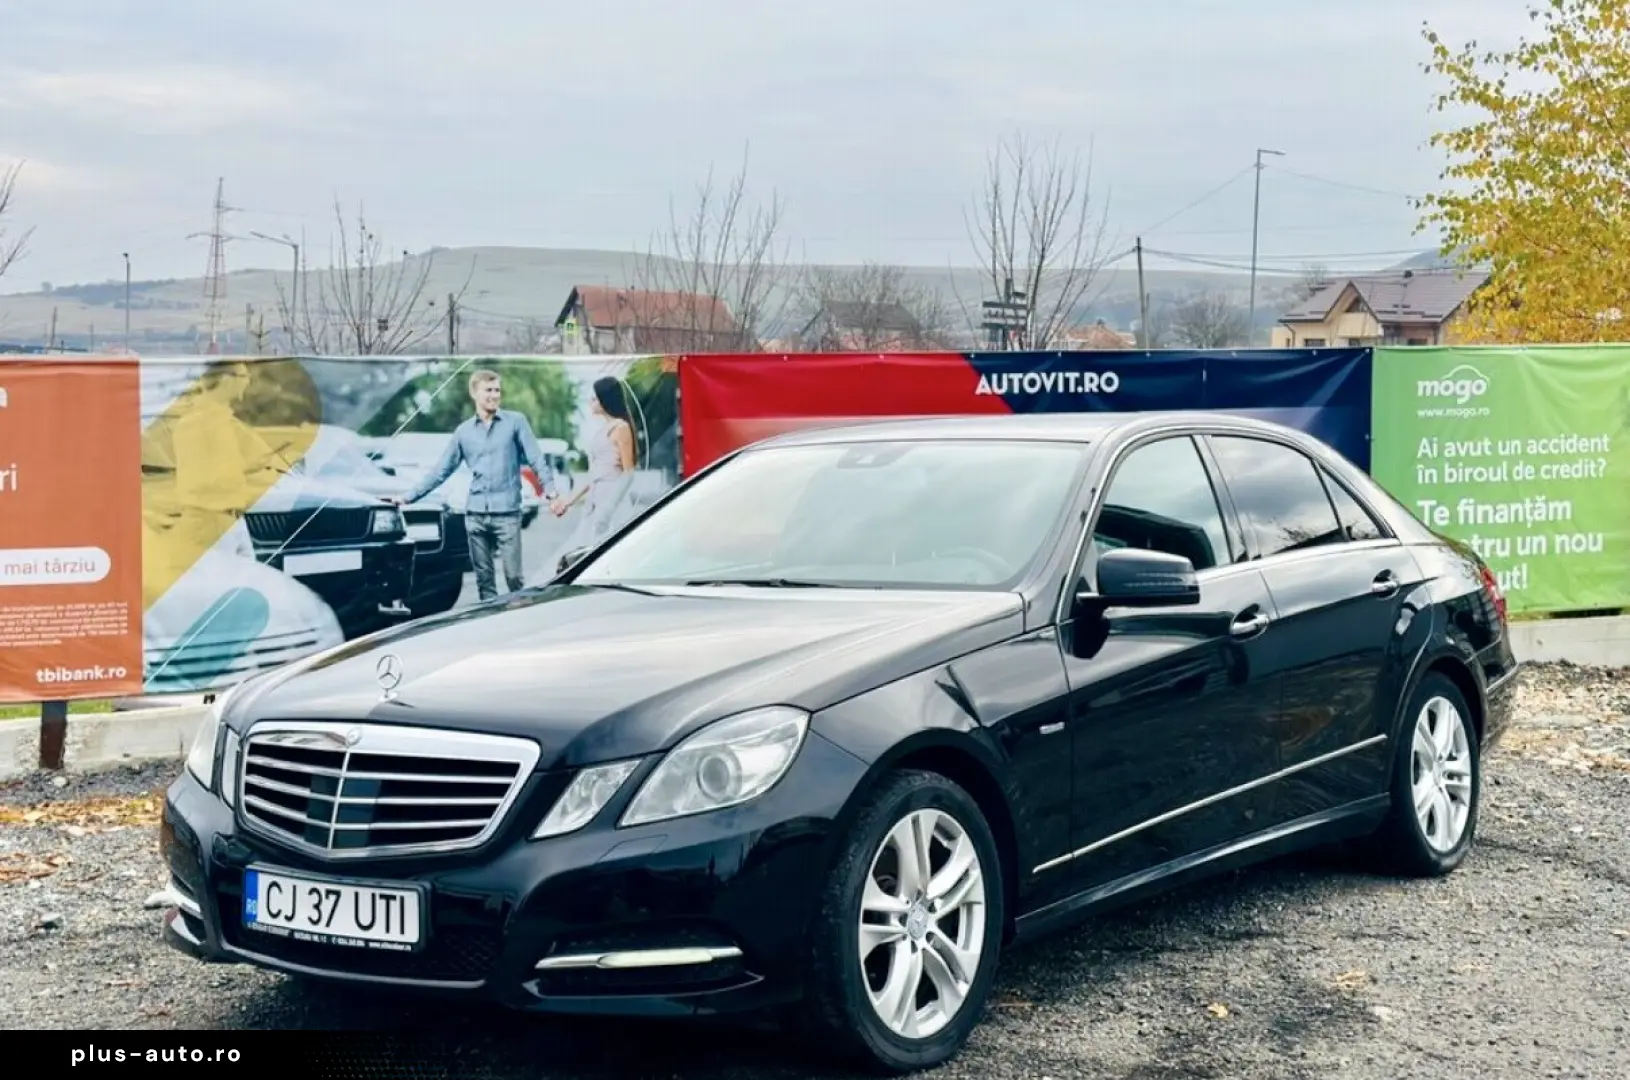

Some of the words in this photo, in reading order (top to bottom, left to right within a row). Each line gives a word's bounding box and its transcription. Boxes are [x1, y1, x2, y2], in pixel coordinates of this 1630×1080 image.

[975, 371, 1119, 395] AUTOVIT.RO
[1417, 379, 1487, 404] mogo
[1417, 407, 1490, 418] www.mogo.ro
[1417, 438, 1438, 458] Ai
[1444, 437, 1492, 457] avut
[1498, 439, 1521, 456] un
[1527, 433, 1610, 454] accident
[0, 462, 17, 491] ri
[1417, 464, 1437, 484] în
[1444, 461, 1508, 484] biroul
[1513, 462, 1535, 481] de
[1540, 458, 1607, 479] credit?
[1417, 500, 1450, 527] Te
[1457, 496, 1572, 528] finanțăm
[1460, 534, 1510, 558] tru
[1517, 535, 1546, 556] un
[1555, 532, 1603, 554] nou
[4, 559, 38, 575] mai
[44, 557, 97, 575] târziu
[1497, 563, 1527, 591] ut!
[36, 664, 127, 683] tbibank.ro
[266, 880, 297, 922] CJ
[307, 887, 342, 928] 37
[354, 891, 405, 935] UTI
